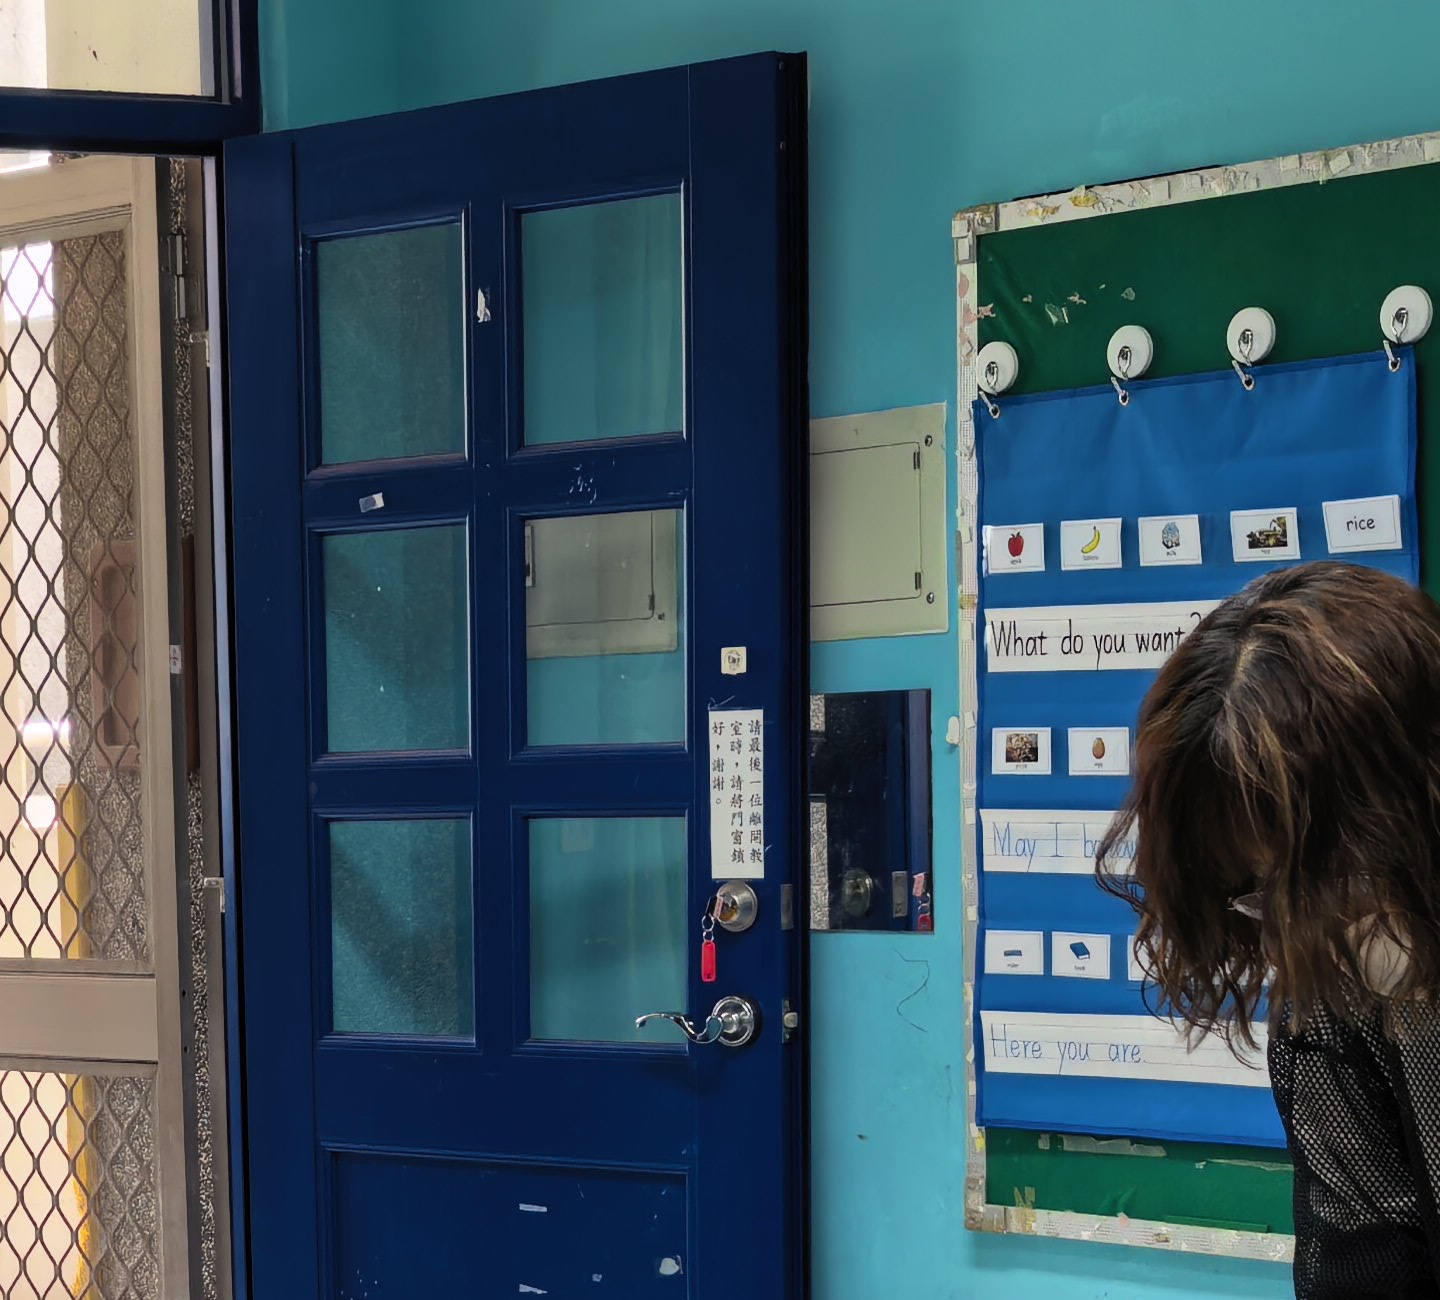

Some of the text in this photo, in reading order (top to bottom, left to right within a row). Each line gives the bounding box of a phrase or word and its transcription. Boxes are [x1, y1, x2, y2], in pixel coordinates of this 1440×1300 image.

[1345, 516, 1376, 532] rice
[991, 619, 1048, 657] What
[1060, 618, 1084, 655] do
[1093, 633, 1126, 671] you
[992, 821, 1037, 872] May
[1049, 821, 1061, 857] I
[989, 1023, 1043, 1060] Here
[1057, 1040, 1089, 1075] you
